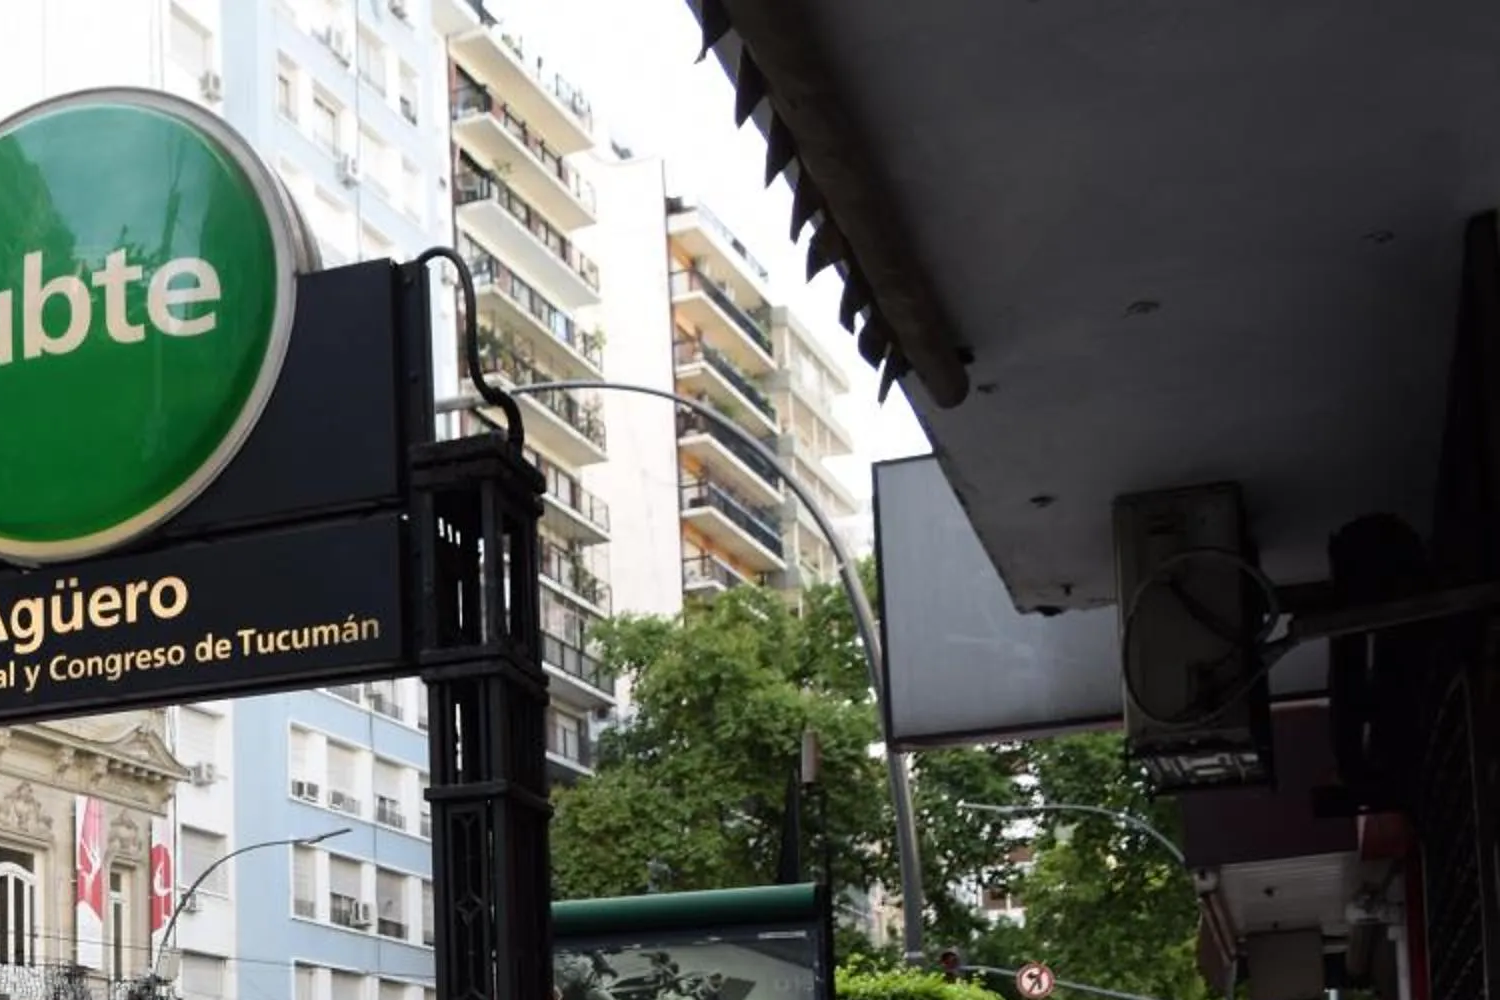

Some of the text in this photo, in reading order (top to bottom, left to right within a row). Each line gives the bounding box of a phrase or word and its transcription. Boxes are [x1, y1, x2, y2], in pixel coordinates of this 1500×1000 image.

[24, 664, 41, 692] y
[50, 645, 185, 681] Congreso
[195, 633, 232, 662] de
[237, 614, 380, 656] Tucumán
